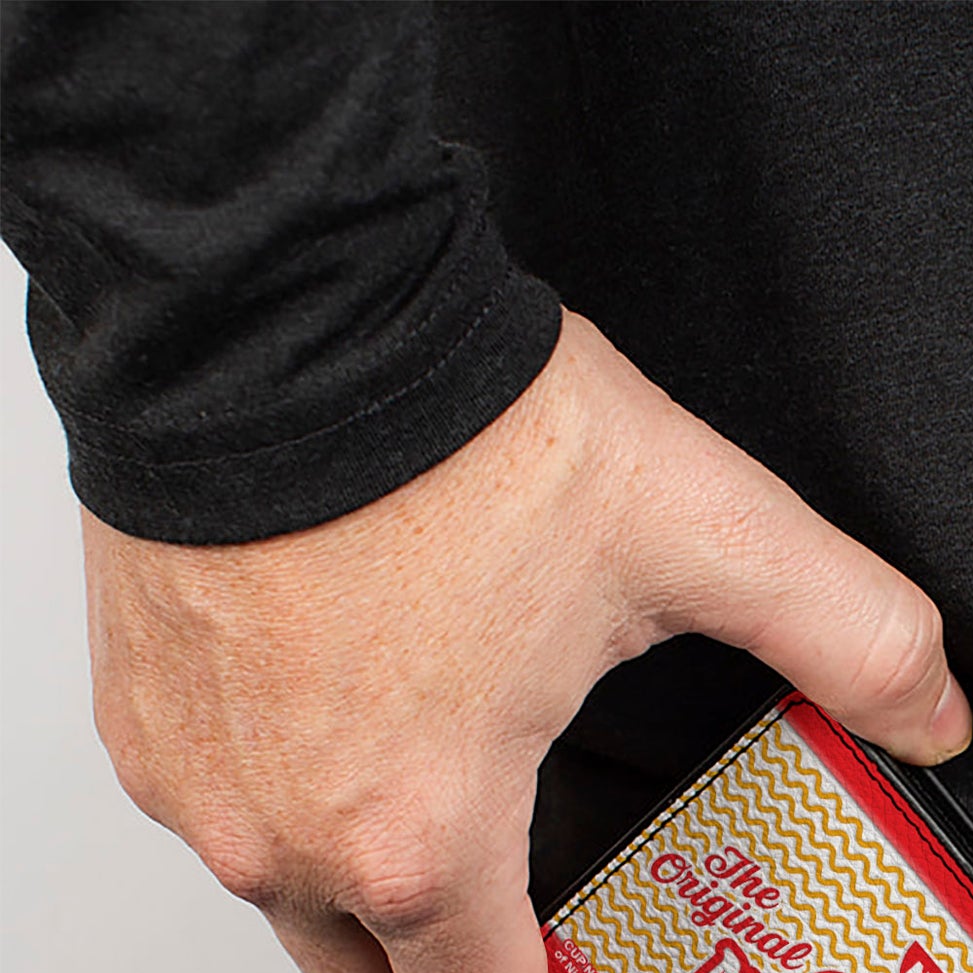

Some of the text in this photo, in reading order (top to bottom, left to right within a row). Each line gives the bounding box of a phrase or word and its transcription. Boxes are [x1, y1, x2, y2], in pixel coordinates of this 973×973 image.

[704, 846, 780, 909] The
[650, 853, 813, 970] Original
[554, 950, 568, 963] of
[564, 940, 586, 964] CUP
